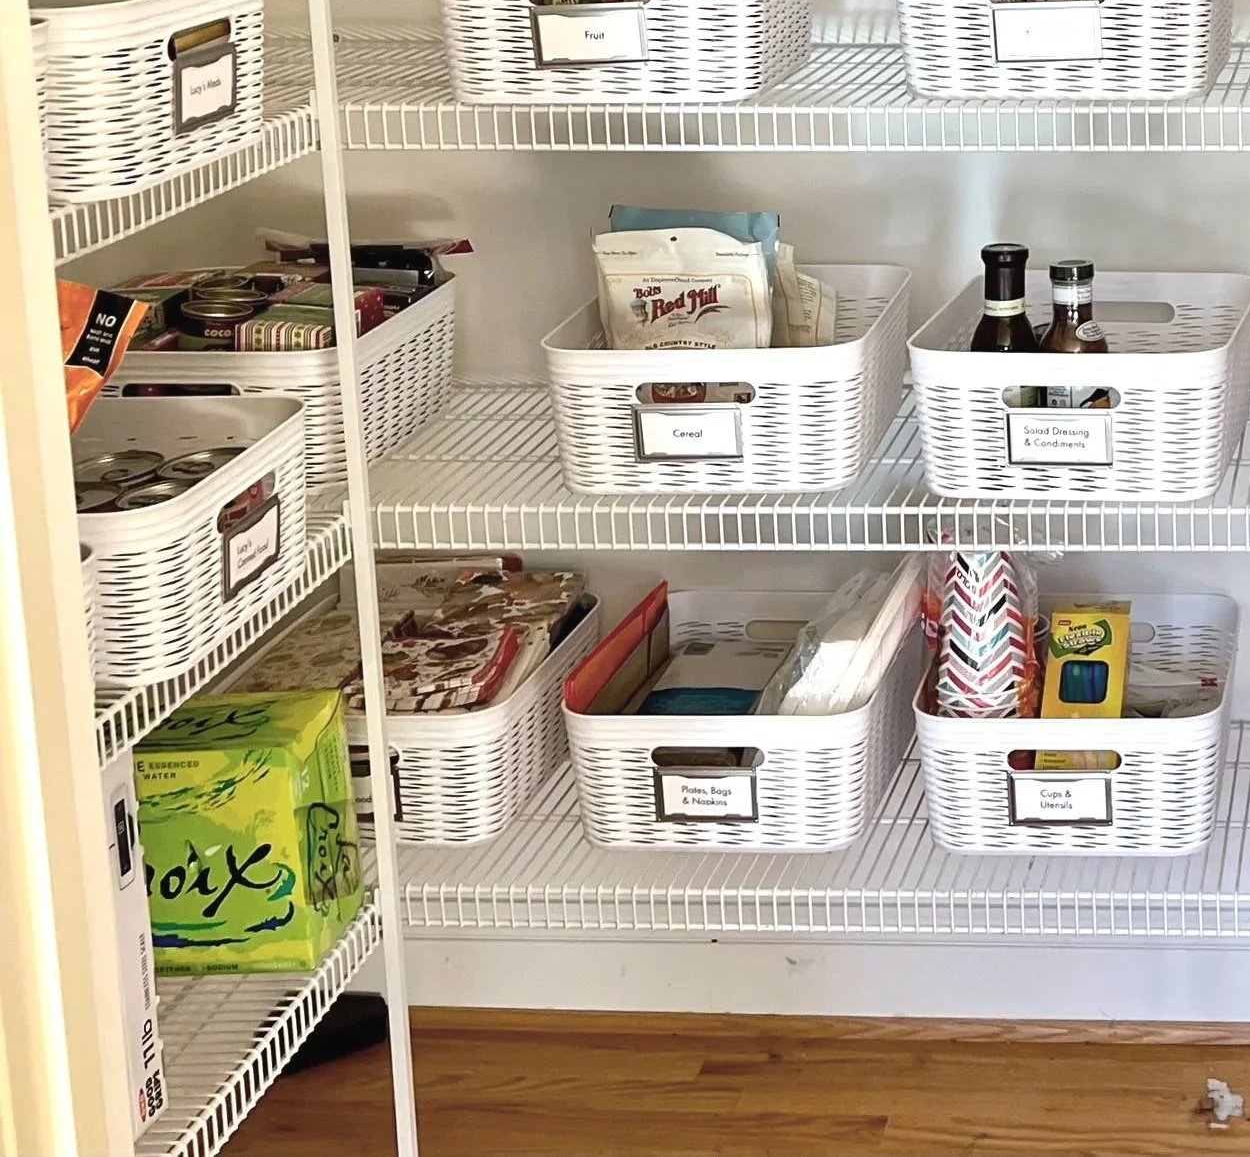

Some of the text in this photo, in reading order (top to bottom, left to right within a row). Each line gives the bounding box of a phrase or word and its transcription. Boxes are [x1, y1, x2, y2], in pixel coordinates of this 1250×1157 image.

[584, 30, 605, 40] Fruit
[632, 285, 662, 299] Bob's
[650, 290, 686, 324] Red
[686, 283, 719, 315] Mill
[95, 313, 117, 328] NO
[660, 340, 692, 348] COUNTRY
[694, 342, 717, 350] STYLE
[672, 429, 704, 439] Cereal
[1023, 425, 1090, 439] Salad Dressing
[1024, 438, 1086, 449] & Condiments
[149, 760, 200, 770] ESSENCED
[144, 772, 177, 780] WATER
[681, 785, 732, 797] Plates, Bags
[1040, 789, 1073, 799] Cups &
[682, 796, 728, 807] & Napkins
[1040, 801, 1073, 810] Utensils
[206, 963, 239, 972] SODIUM
[145, 1075, 156, 1118] GOOD
